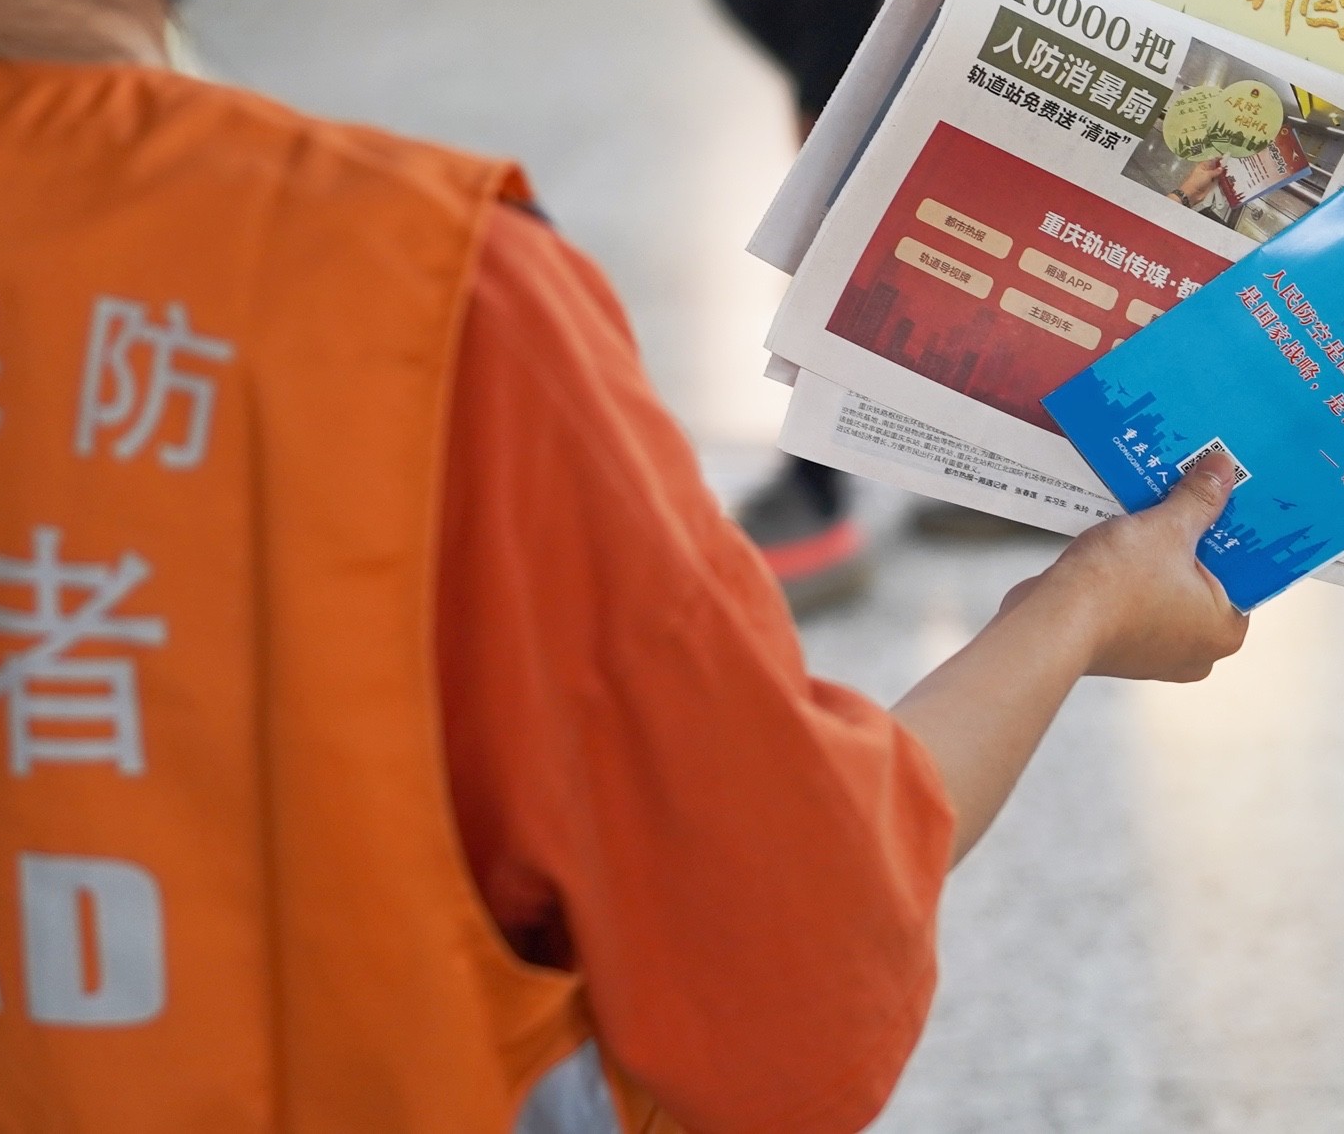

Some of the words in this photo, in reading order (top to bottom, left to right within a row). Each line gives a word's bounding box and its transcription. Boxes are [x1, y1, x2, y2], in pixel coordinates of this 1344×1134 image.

[992, 26, 1158, 125] 人防消暑扇
[966, 64, 1132, 151] 轨道站免费送“清凉”
[944, 215, 987, 243] 都市热报
[918, 251, 972, 285] 轨道导视牌
[1028, 306, 1073, 334] 主题列车
[1112, 436, 1146, 476] CHONGQING
